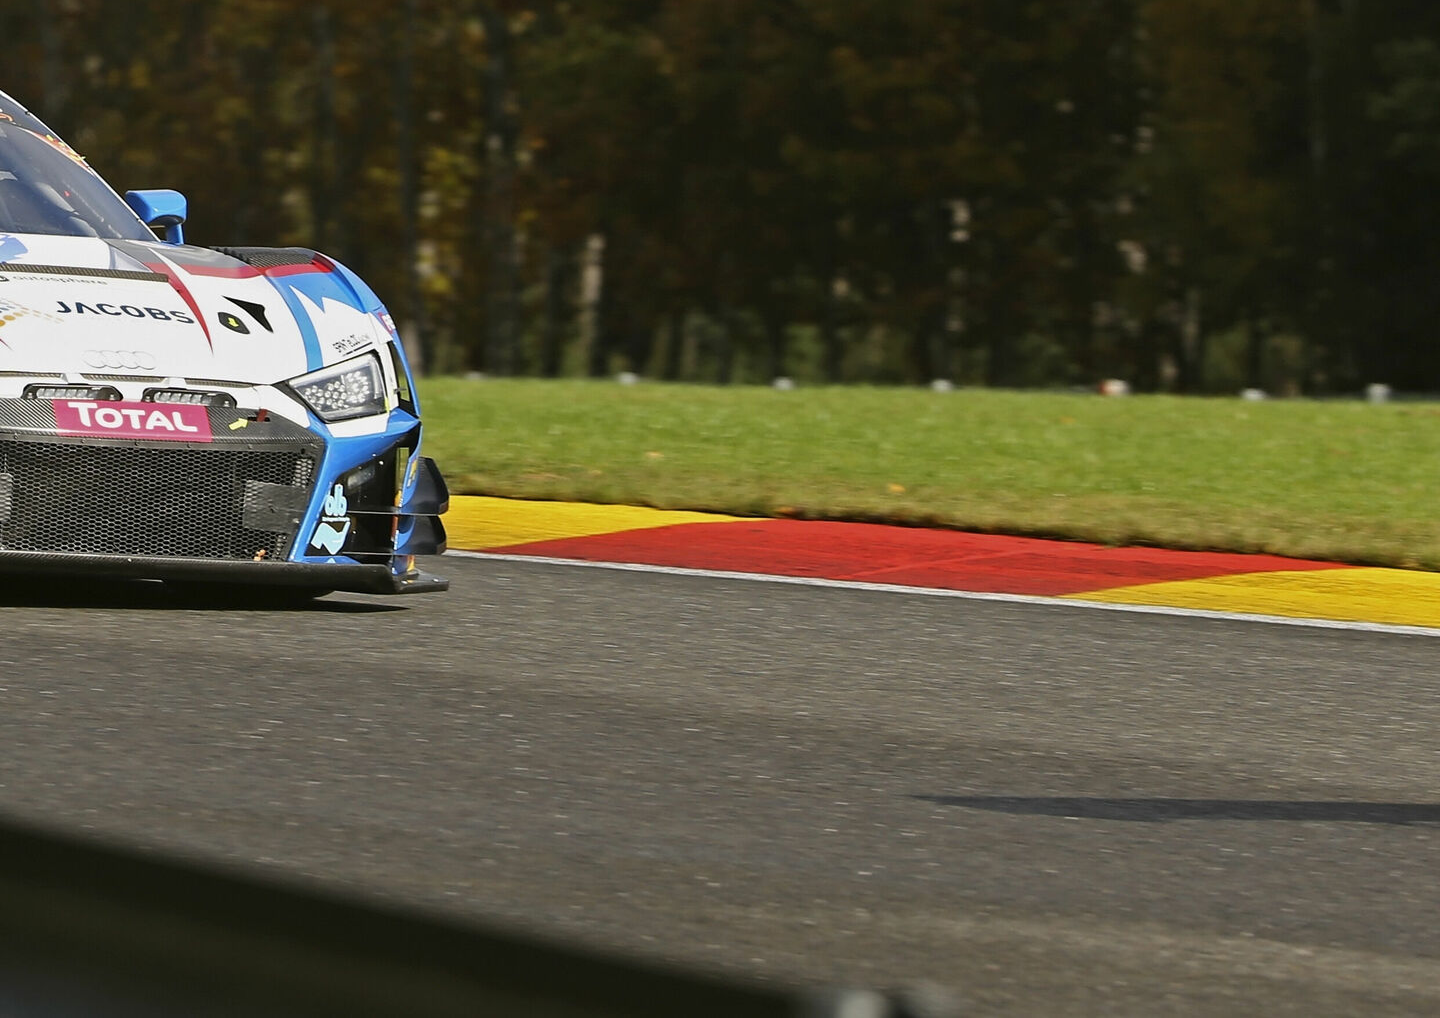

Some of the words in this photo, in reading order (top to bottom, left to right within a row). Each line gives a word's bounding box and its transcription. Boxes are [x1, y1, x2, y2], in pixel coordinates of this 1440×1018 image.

[13, 273, 108, 286] autosphere
[56, 300, 195, 324] JACOBS
[67, 401, 198, 433] TOTAL
